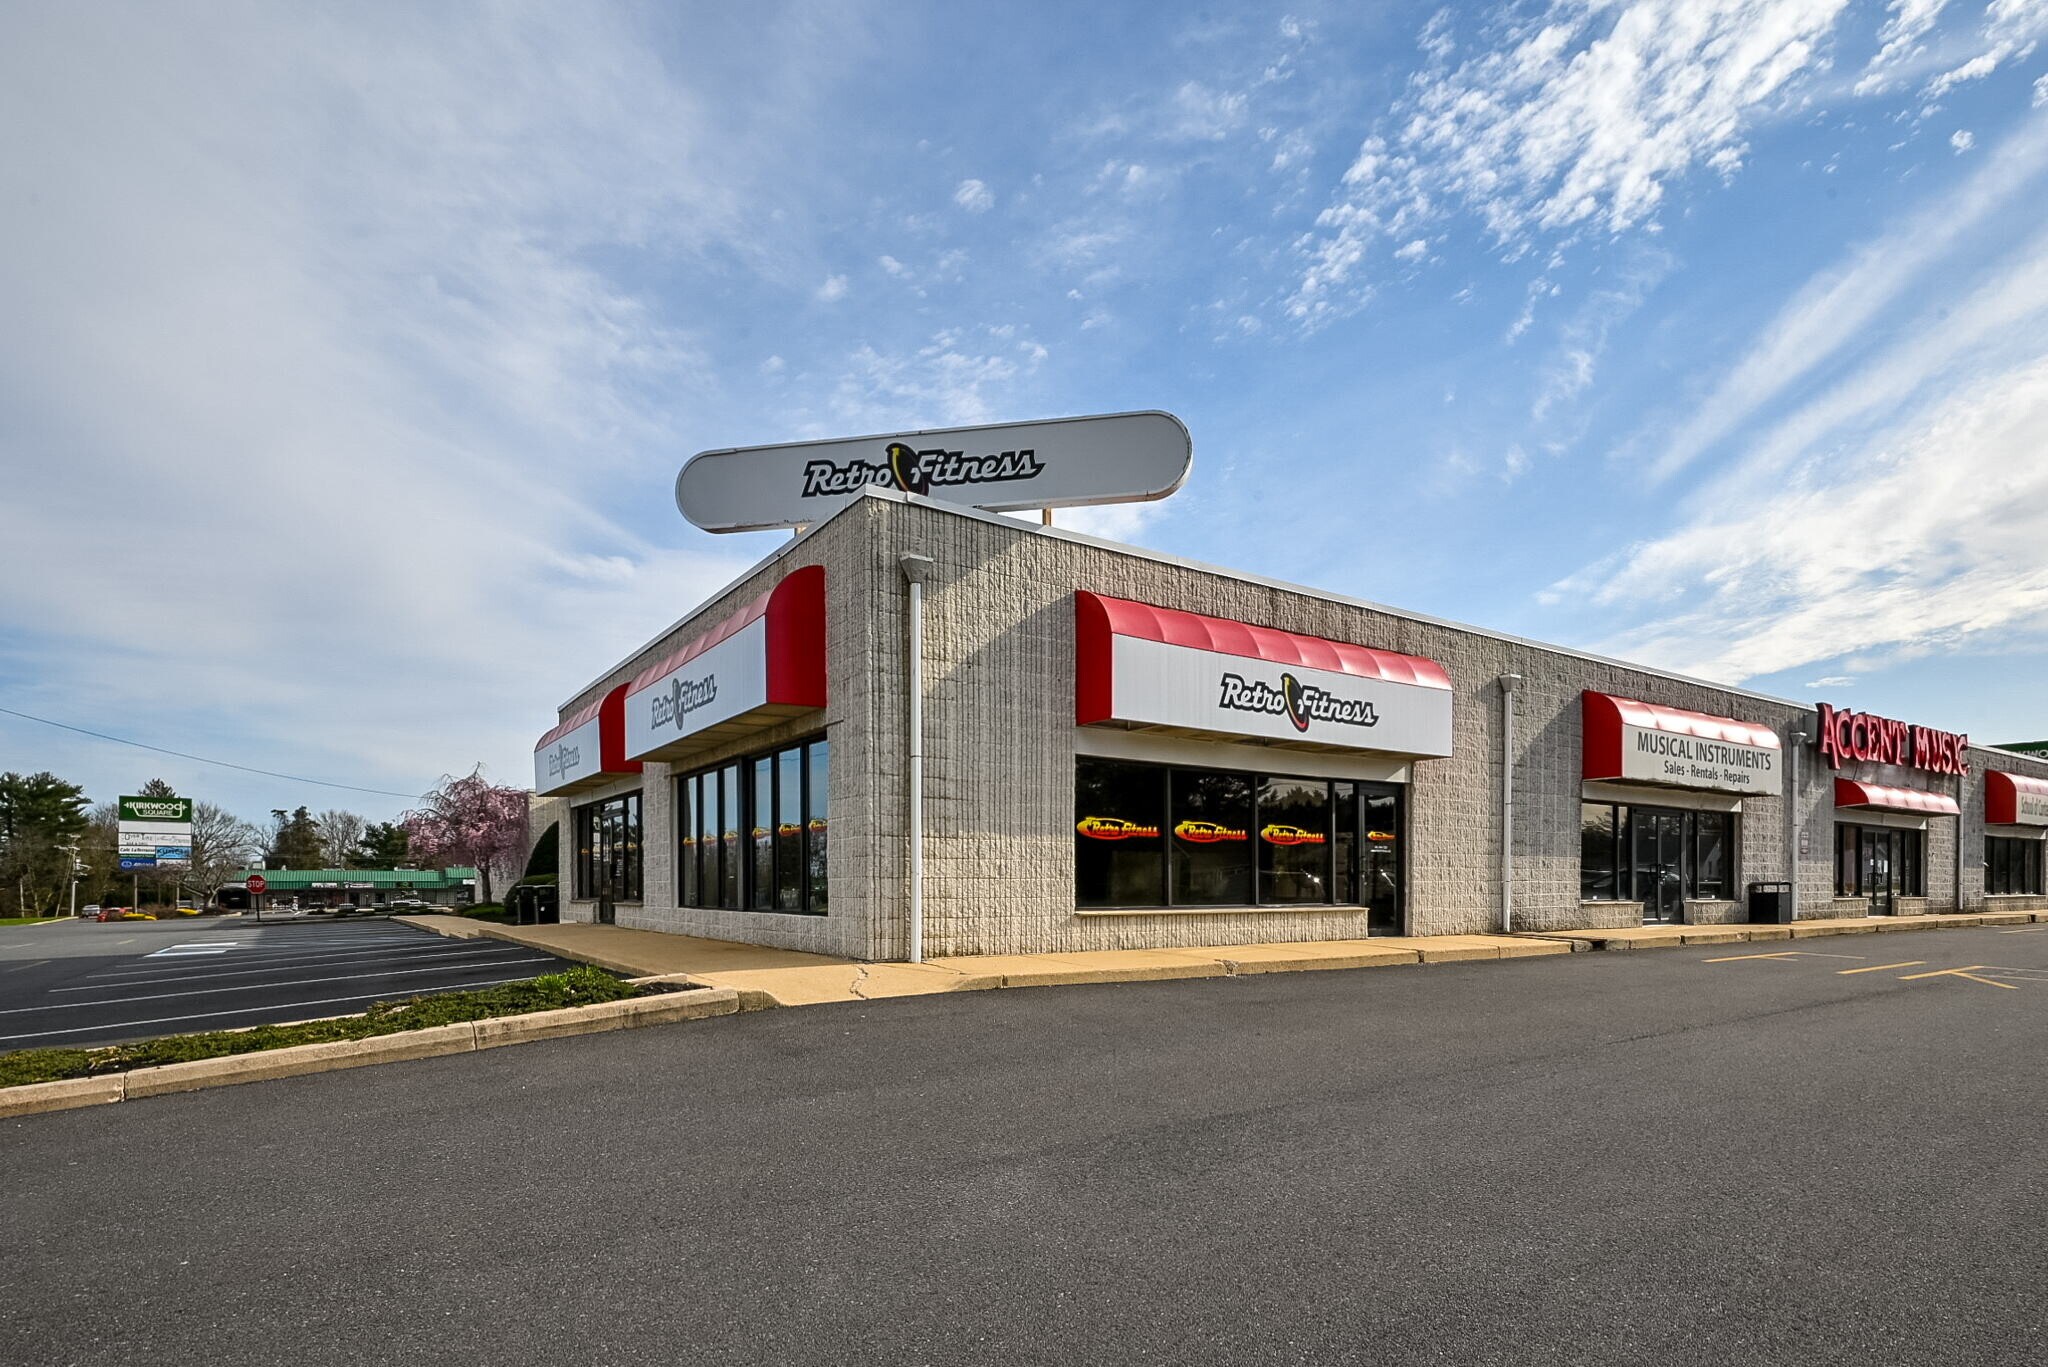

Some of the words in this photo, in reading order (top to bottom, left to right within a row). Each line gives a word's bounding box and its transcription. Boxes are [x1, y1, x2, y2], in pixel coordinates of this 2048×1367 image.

[803, 461, 892, 496] Retro
[911, 451, 1043, 485] Fitness
[651, 693, 675, 730] Retro
[676, 674, 717, 715] Fitness
[1220, 673, 1285, 714] Retro
[1297, 686, 1378, 727] Fitness
[1637, 731, 1693, 760] MUSICAL
[1695, 742, 1772, 770] INSTRUMENTS
[1817, 703, 1909, 769] ACCENT
[1911, 725, 1969, 777] MUSIC
[1664, 760, 1685, 776] Sales
[1690, 764, 1718, 781] Rentals
[1723, 769, 1750, 785] Repairs
[1092, 821, 1119, 836] Retro
[1121, 822, 1160, 837] Fitness
[1188, 825, 1212, 839] Retro
[1214, 826, 1248, 840] Fitness
[247, 880, 265, 888] STOP
